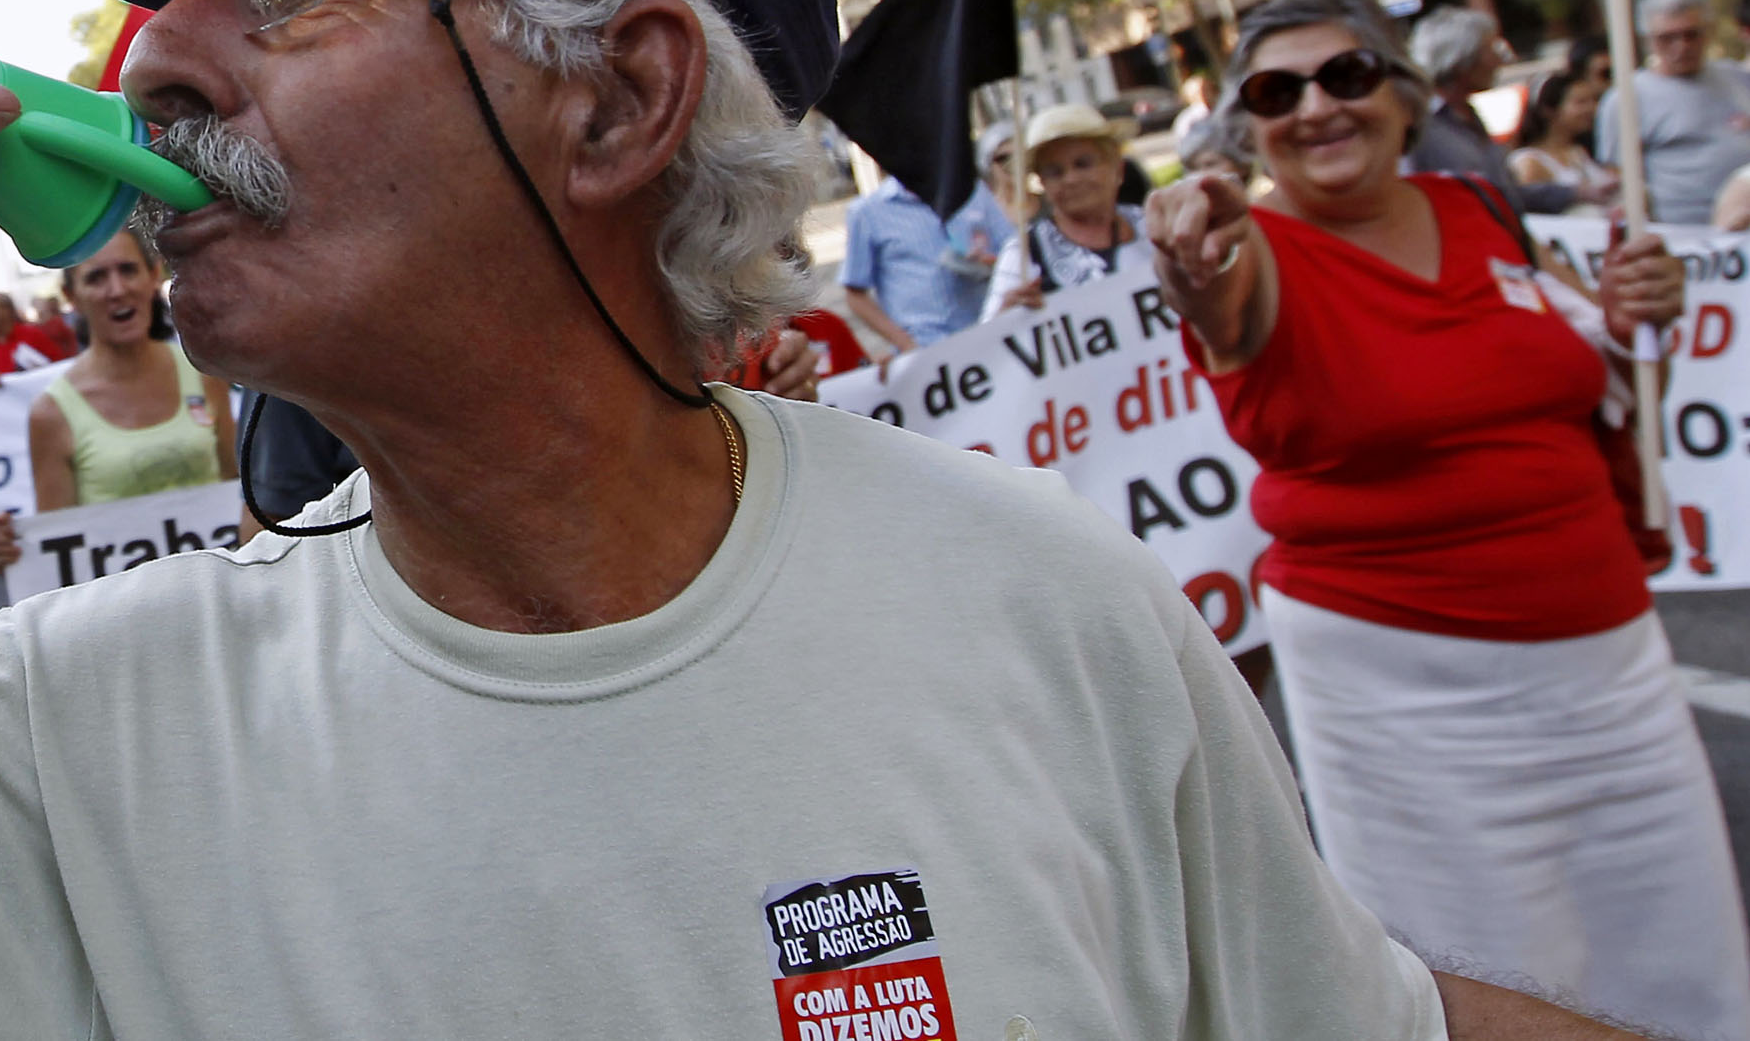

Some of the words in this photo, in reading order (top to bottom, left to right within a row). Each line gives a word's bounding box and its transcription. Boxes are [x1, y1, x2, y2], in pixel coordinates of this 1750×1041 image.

[922, 364, 993, 418] de
[1003, 313, 1118, 379] Vila
[1132, 287, 1180, 340] R
[1027, 400, 1091, 467] de
[1116, 358, 1200, 433] dir
[774, 881, 903, 938] PROGRAMA
[783, 937, 813, 967] DE
[817, 914, 913, 960] AGRESSÃO
[793, 987, 849, 1018] COM
[854, 984, 872, 1010] A
[873, 976, 933, 1007] LUTA
[798, 1003, 940, 1041] DIZEMOS
